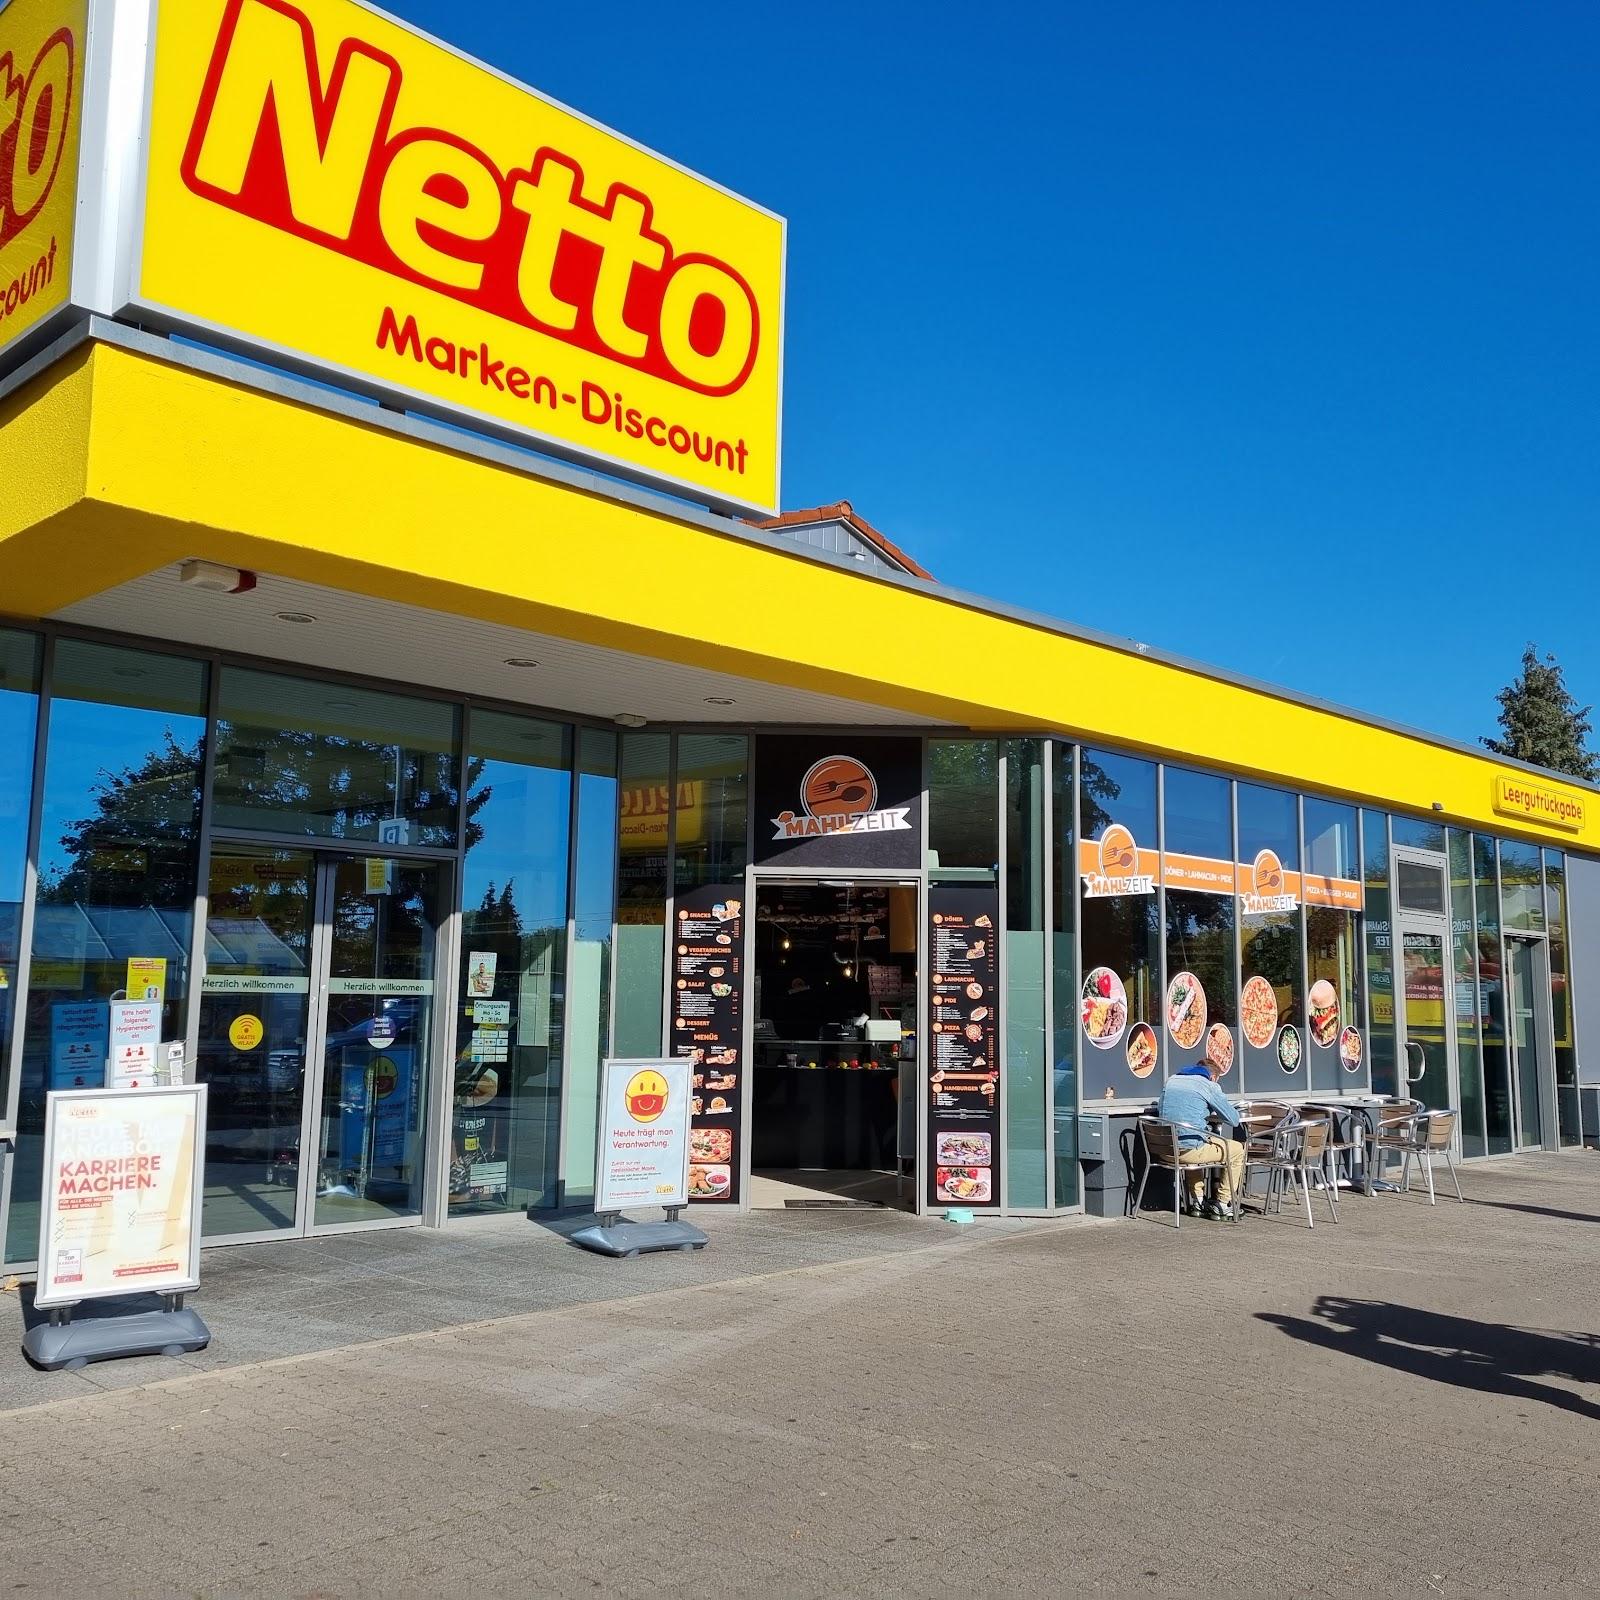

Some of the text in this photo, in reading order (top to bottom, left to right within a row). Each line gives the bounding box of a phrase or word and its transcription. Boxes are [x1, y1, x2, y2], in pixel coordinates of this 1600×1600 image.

[180, 0, 760, 397] Netto
[375, 306, 749, 475] Marken-Discount
[1502, 781, 1583, 821] Leergutrückgabe
[785, 811, 899, 837] MAHLZEIT
[1165, 866, 1233, 884] DÖNER LAHMACUN PIDE
[1092, 876, 1149, 895] MAHLZEIT
[1248, 895, 1293, 912] MAHLZEIT
[201, 977, 295, 990] Herzlich willkommen
[343, 981, 425, 992] Herzlich willkommen
[693, 1033, 719, 1041] MENÜS
[613, 1128, 674, 1138] Heute trägt man
[612, 1140, 670, 1149] Verantwortung.
[59, 1155, 161, 1178] KARRIERE
[58, 1173, 157, 1195] MACHEN.
